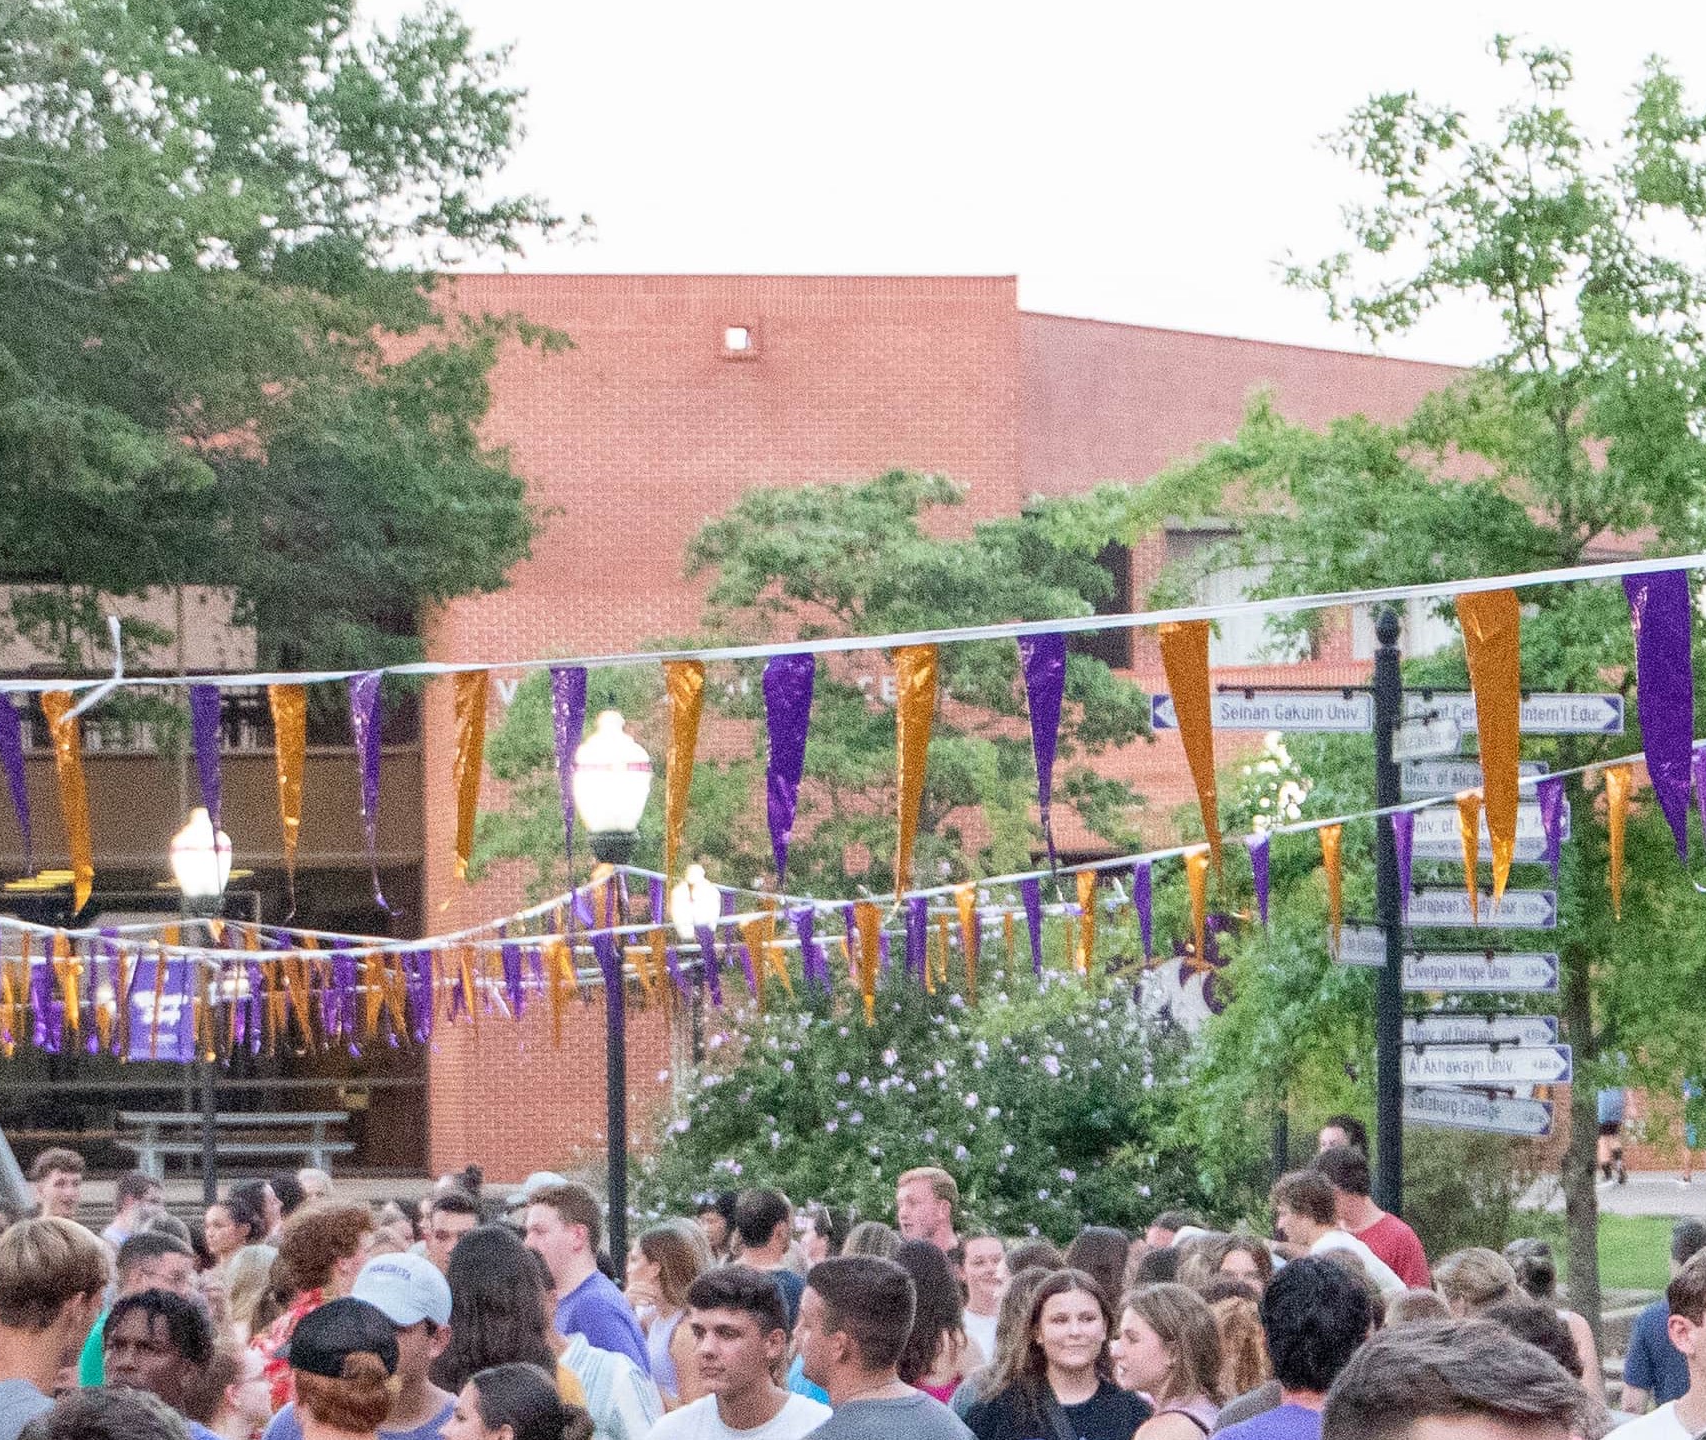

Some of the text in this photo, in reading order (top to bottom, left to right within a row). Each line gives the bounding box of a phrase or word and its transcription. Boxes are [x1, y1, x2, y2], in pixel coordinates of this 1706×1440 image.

[1220, 703, 1270, 721] Seinan
[1274, 702, 1323, 721] Gakuin
[1437, 769, 1448, 786] of
[1407, 963, 1456, 983] Liverpool
[1459, 963, 1486, 983] Hope
[1424, 1057, 1484, 1079] Akhawayn
[1410, 1093, 1458, 1118] Salzburg
[1460, 1099, 1502, 1122] College
